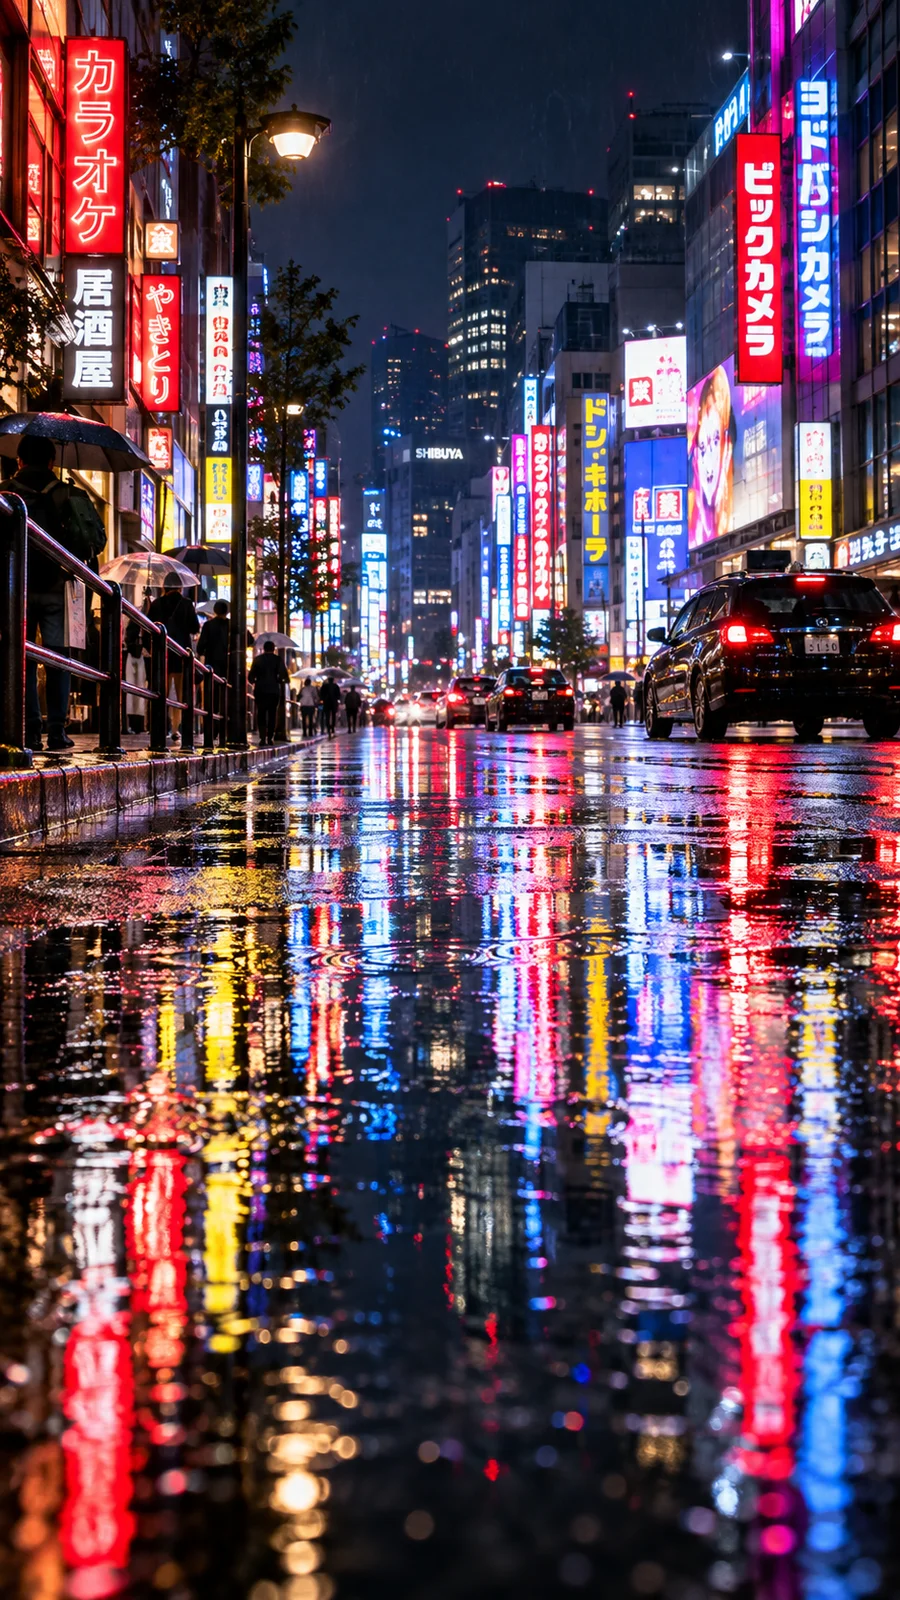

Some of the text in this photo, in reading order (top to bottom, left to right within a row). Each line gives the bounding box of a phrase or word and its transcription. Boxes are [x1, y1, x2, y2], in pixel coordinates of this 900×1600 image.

[71, 50, 117, 243] カラオケ
[744, 162, 775, 356] ビックカメラ
[72, 269, 113, 388] 居酒屋
[145, 283, 175, 404] やきとり
[415, 447, 464, 460] SHIBUYA
